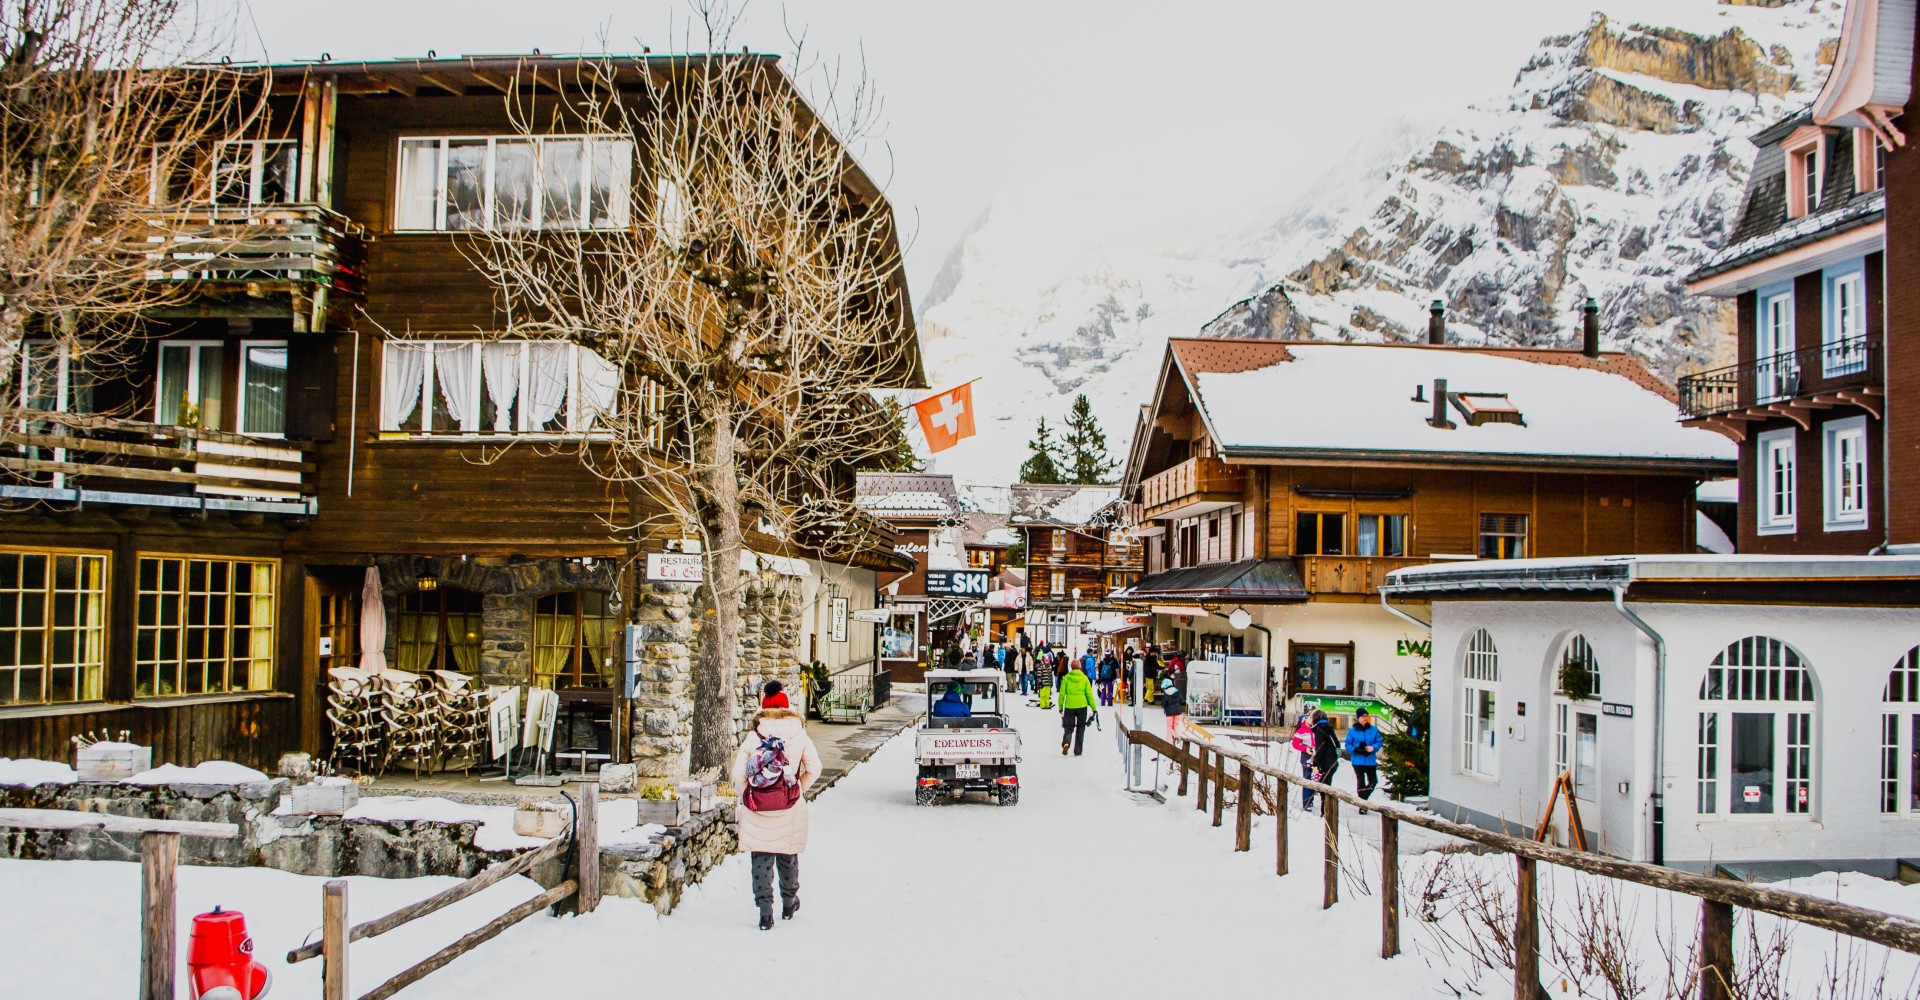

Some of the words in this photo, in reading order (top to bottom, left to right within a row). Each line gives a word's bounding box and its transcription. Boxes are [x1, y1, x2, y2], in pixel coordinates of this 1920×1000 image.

[660, 566, 676, 577] La
[952, 573, 988, 593] SKI
[934, 740, 992, 748] EDELWEISS
